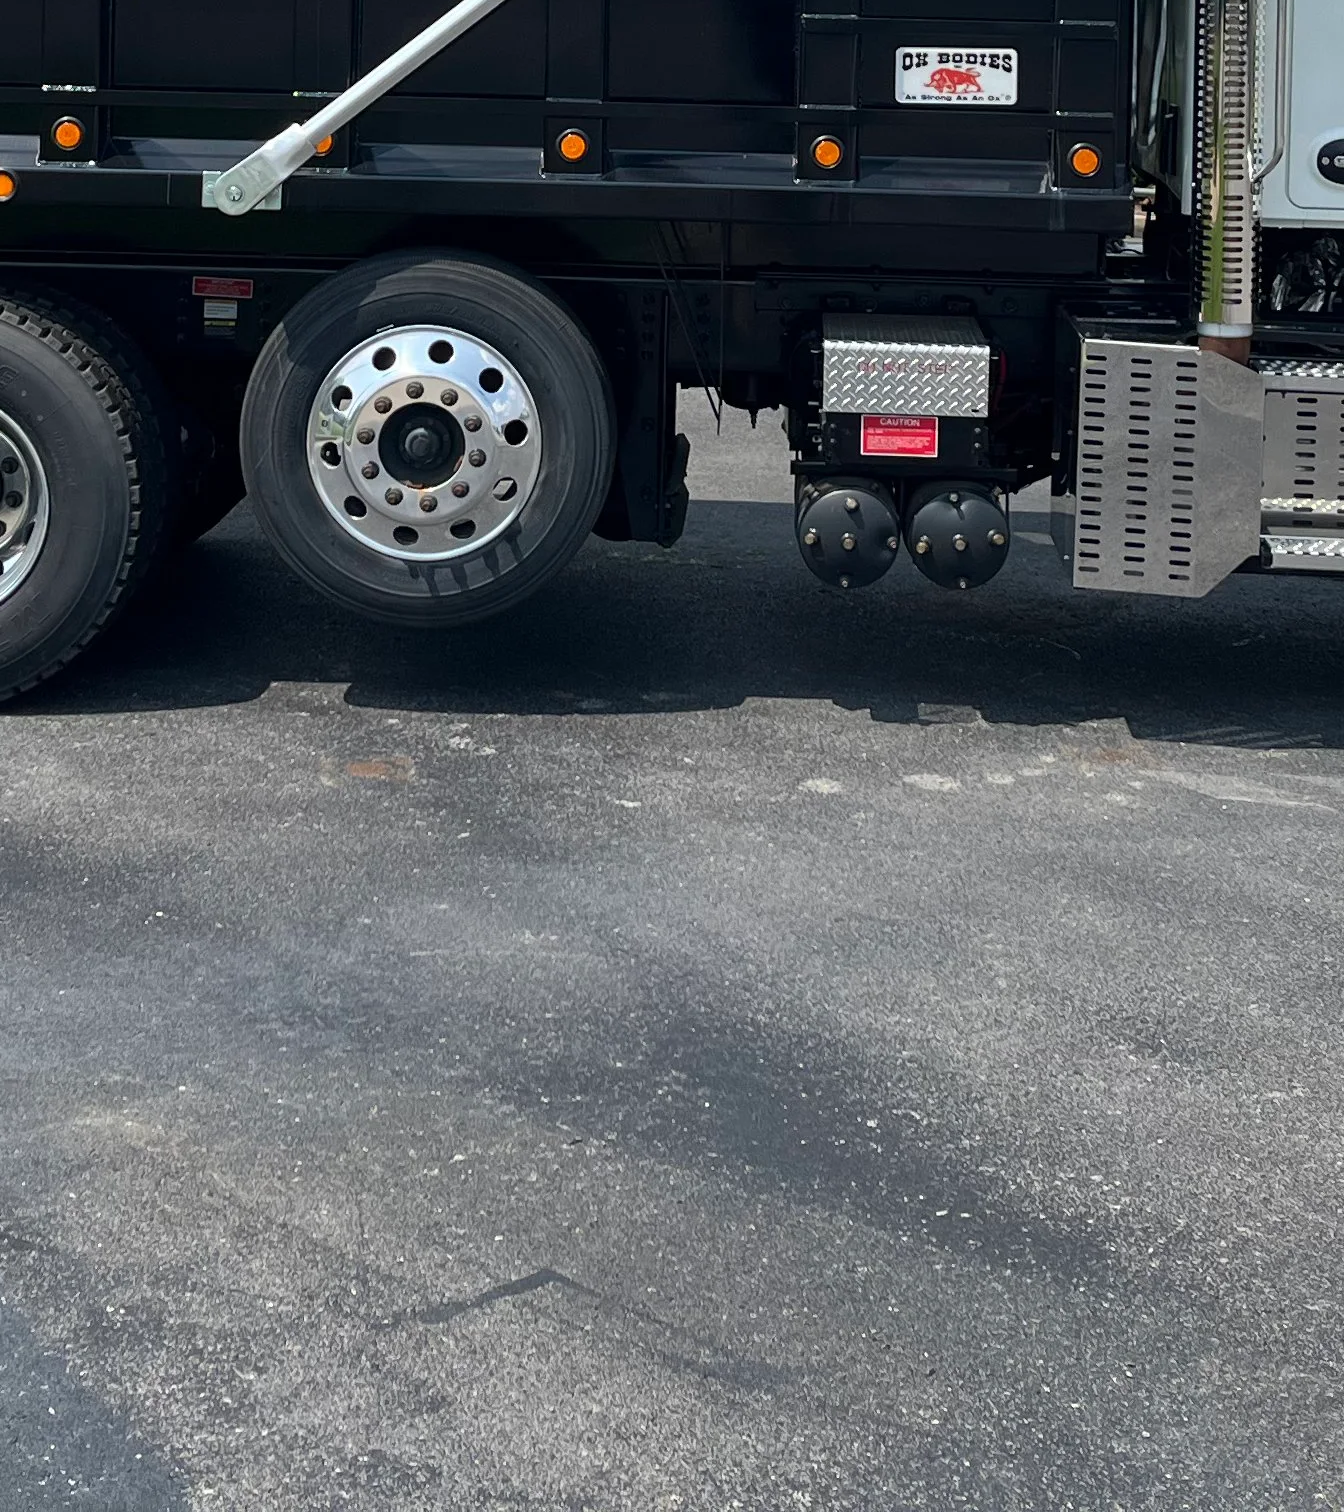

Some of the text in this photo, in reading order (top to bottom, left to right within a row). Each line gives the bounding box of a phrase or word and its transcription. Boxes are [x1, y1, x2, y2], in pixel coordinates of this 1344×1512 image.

[902, 52, 1012, 73] OX BODIES
[879, 417, 921, 427] CAUTION
